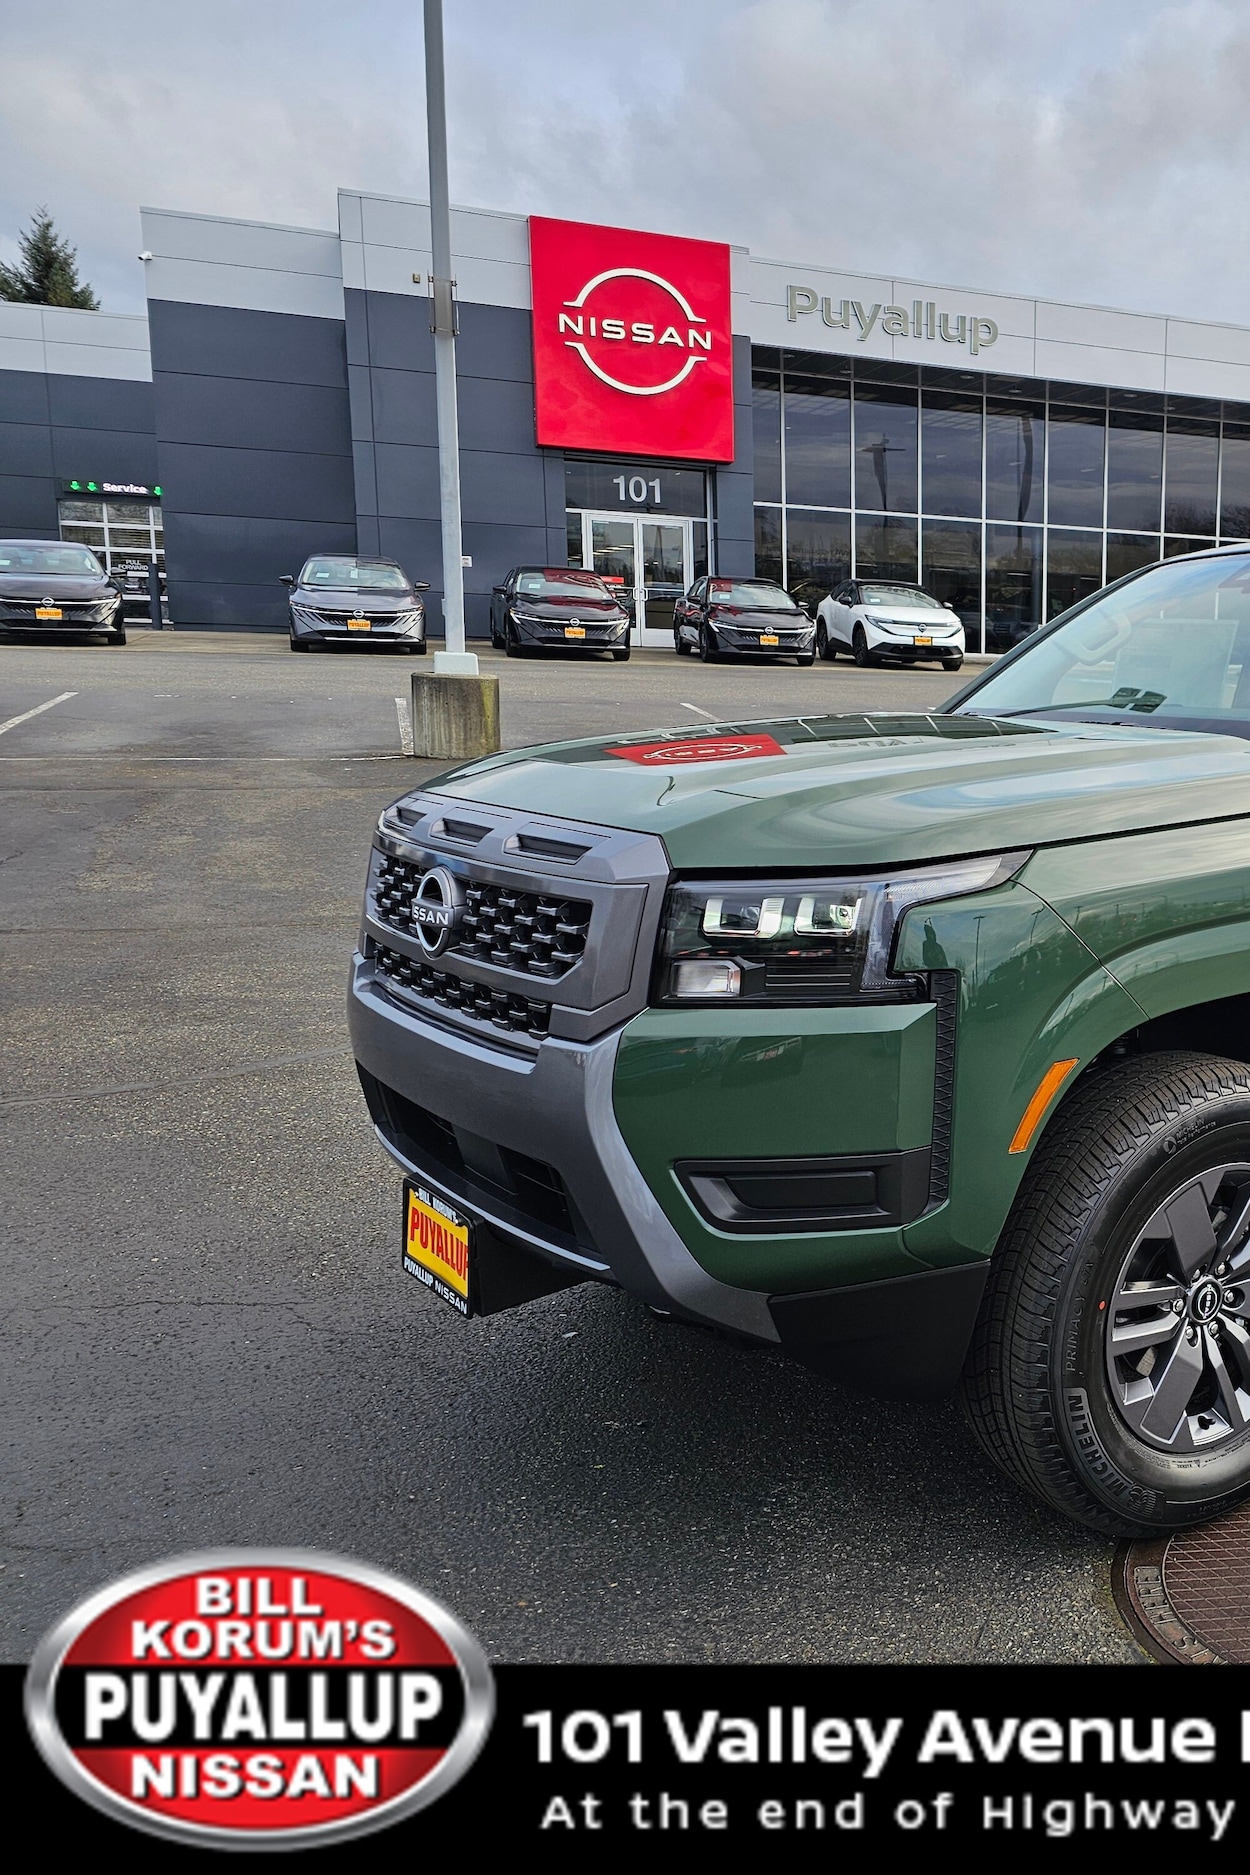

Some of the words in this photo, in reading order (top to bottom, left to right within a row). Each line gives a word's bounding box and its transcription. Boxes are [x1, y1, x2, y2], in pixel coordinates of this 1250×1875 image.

[558, 313, 713, 350] NISSAN
[786, 284, 999, 355] Puyallup
[102, 482, 149, 495] Service
[613, 474, 661, 504] 101
[118, 563, 149, 571] FORWARD
[413, 905, 449, 925] SSAN
[418, 1187, 432, 1206] BILL
[410, 1206, 469, 1281] PUYALLUP
[404, 1256, 434, 1288] PUYALLUP
[434, 1281, 467, 1315] NISSAN
[1065, 1292, 1086, 1372] PRIMACY
[1067, 1394, 1131, 1497] MICHELIN
[1133, 1567, 1178, 1625] HERE
